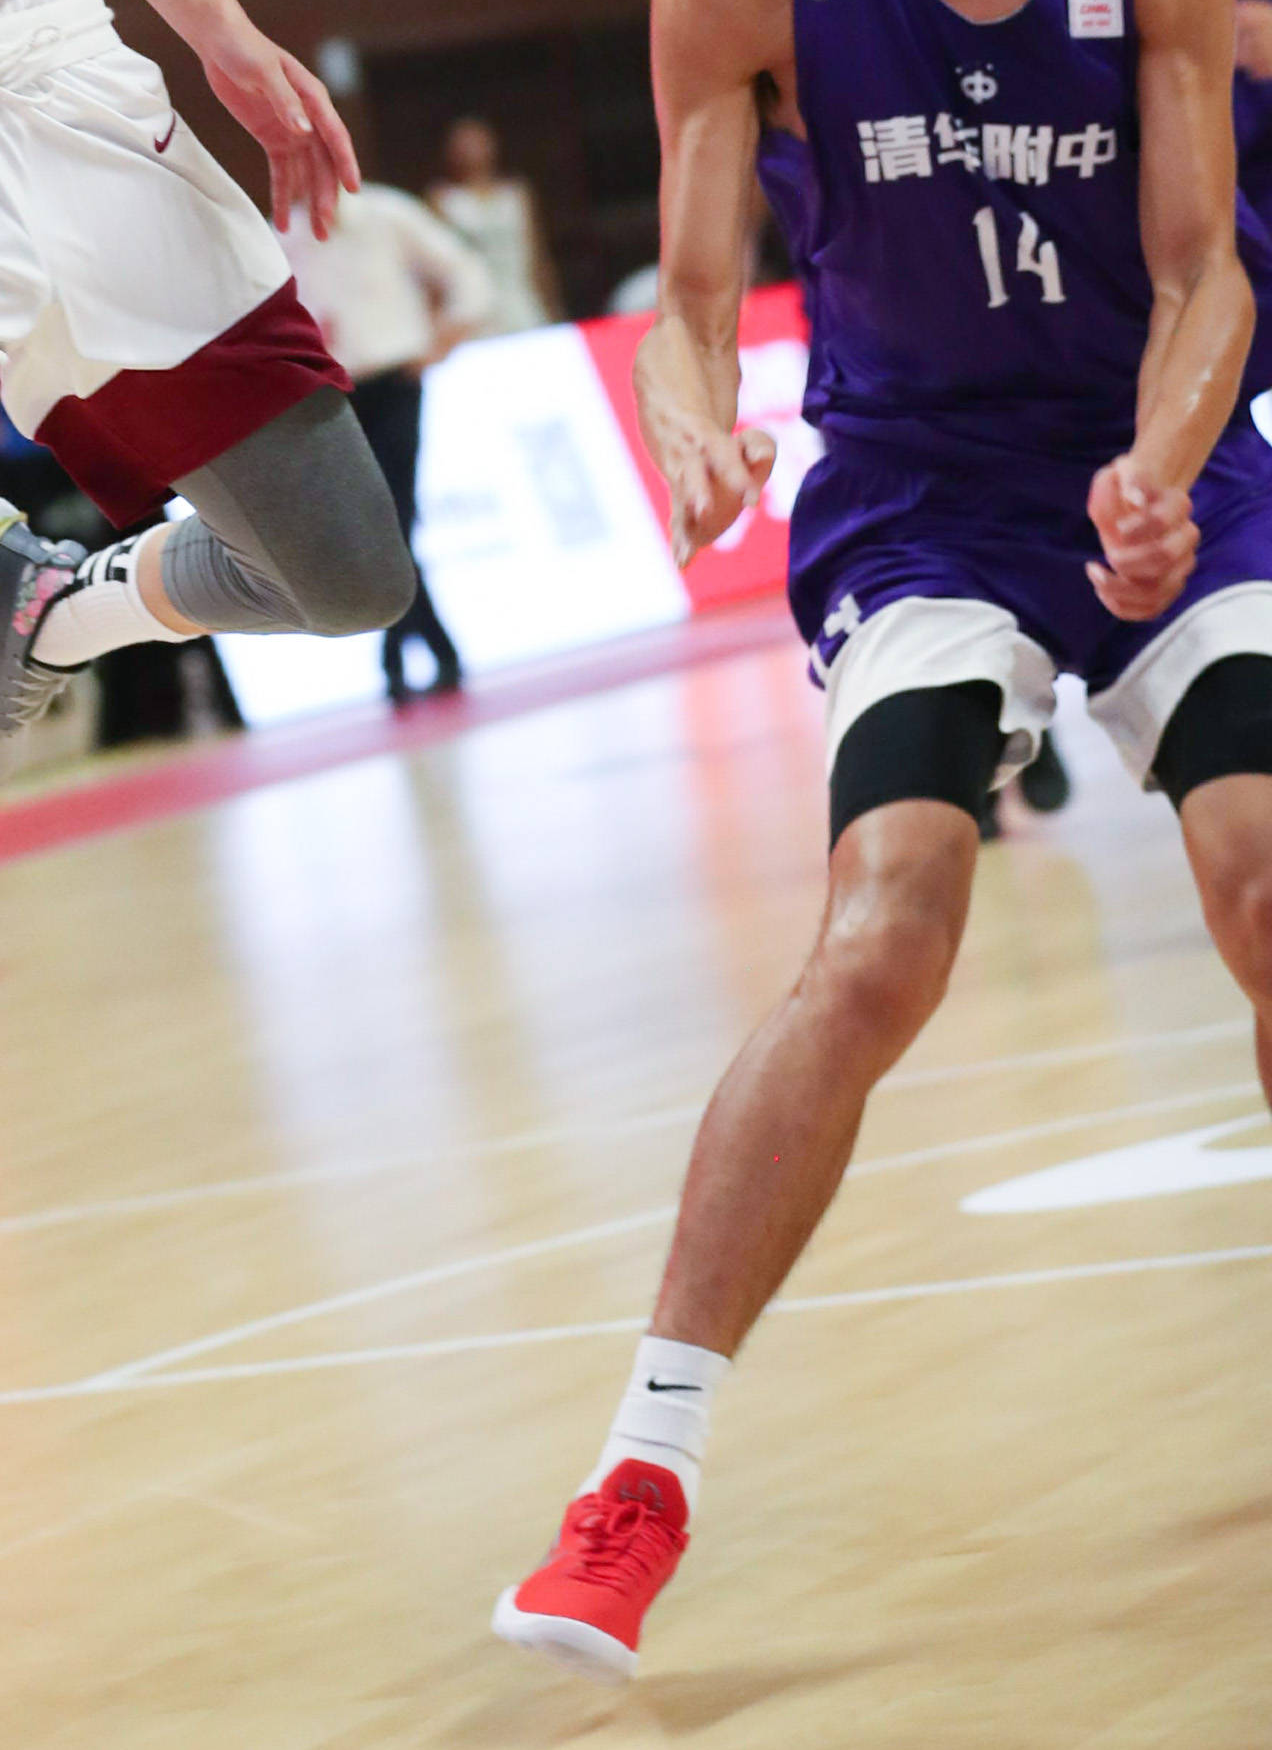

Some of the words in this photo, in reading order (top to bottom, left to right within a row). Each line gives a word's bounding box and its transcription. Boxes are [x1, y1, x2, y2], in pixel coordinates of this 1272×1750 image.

[857, 112, 1118, 187] 清华附中
[972, 206, 1068, 309] 14
